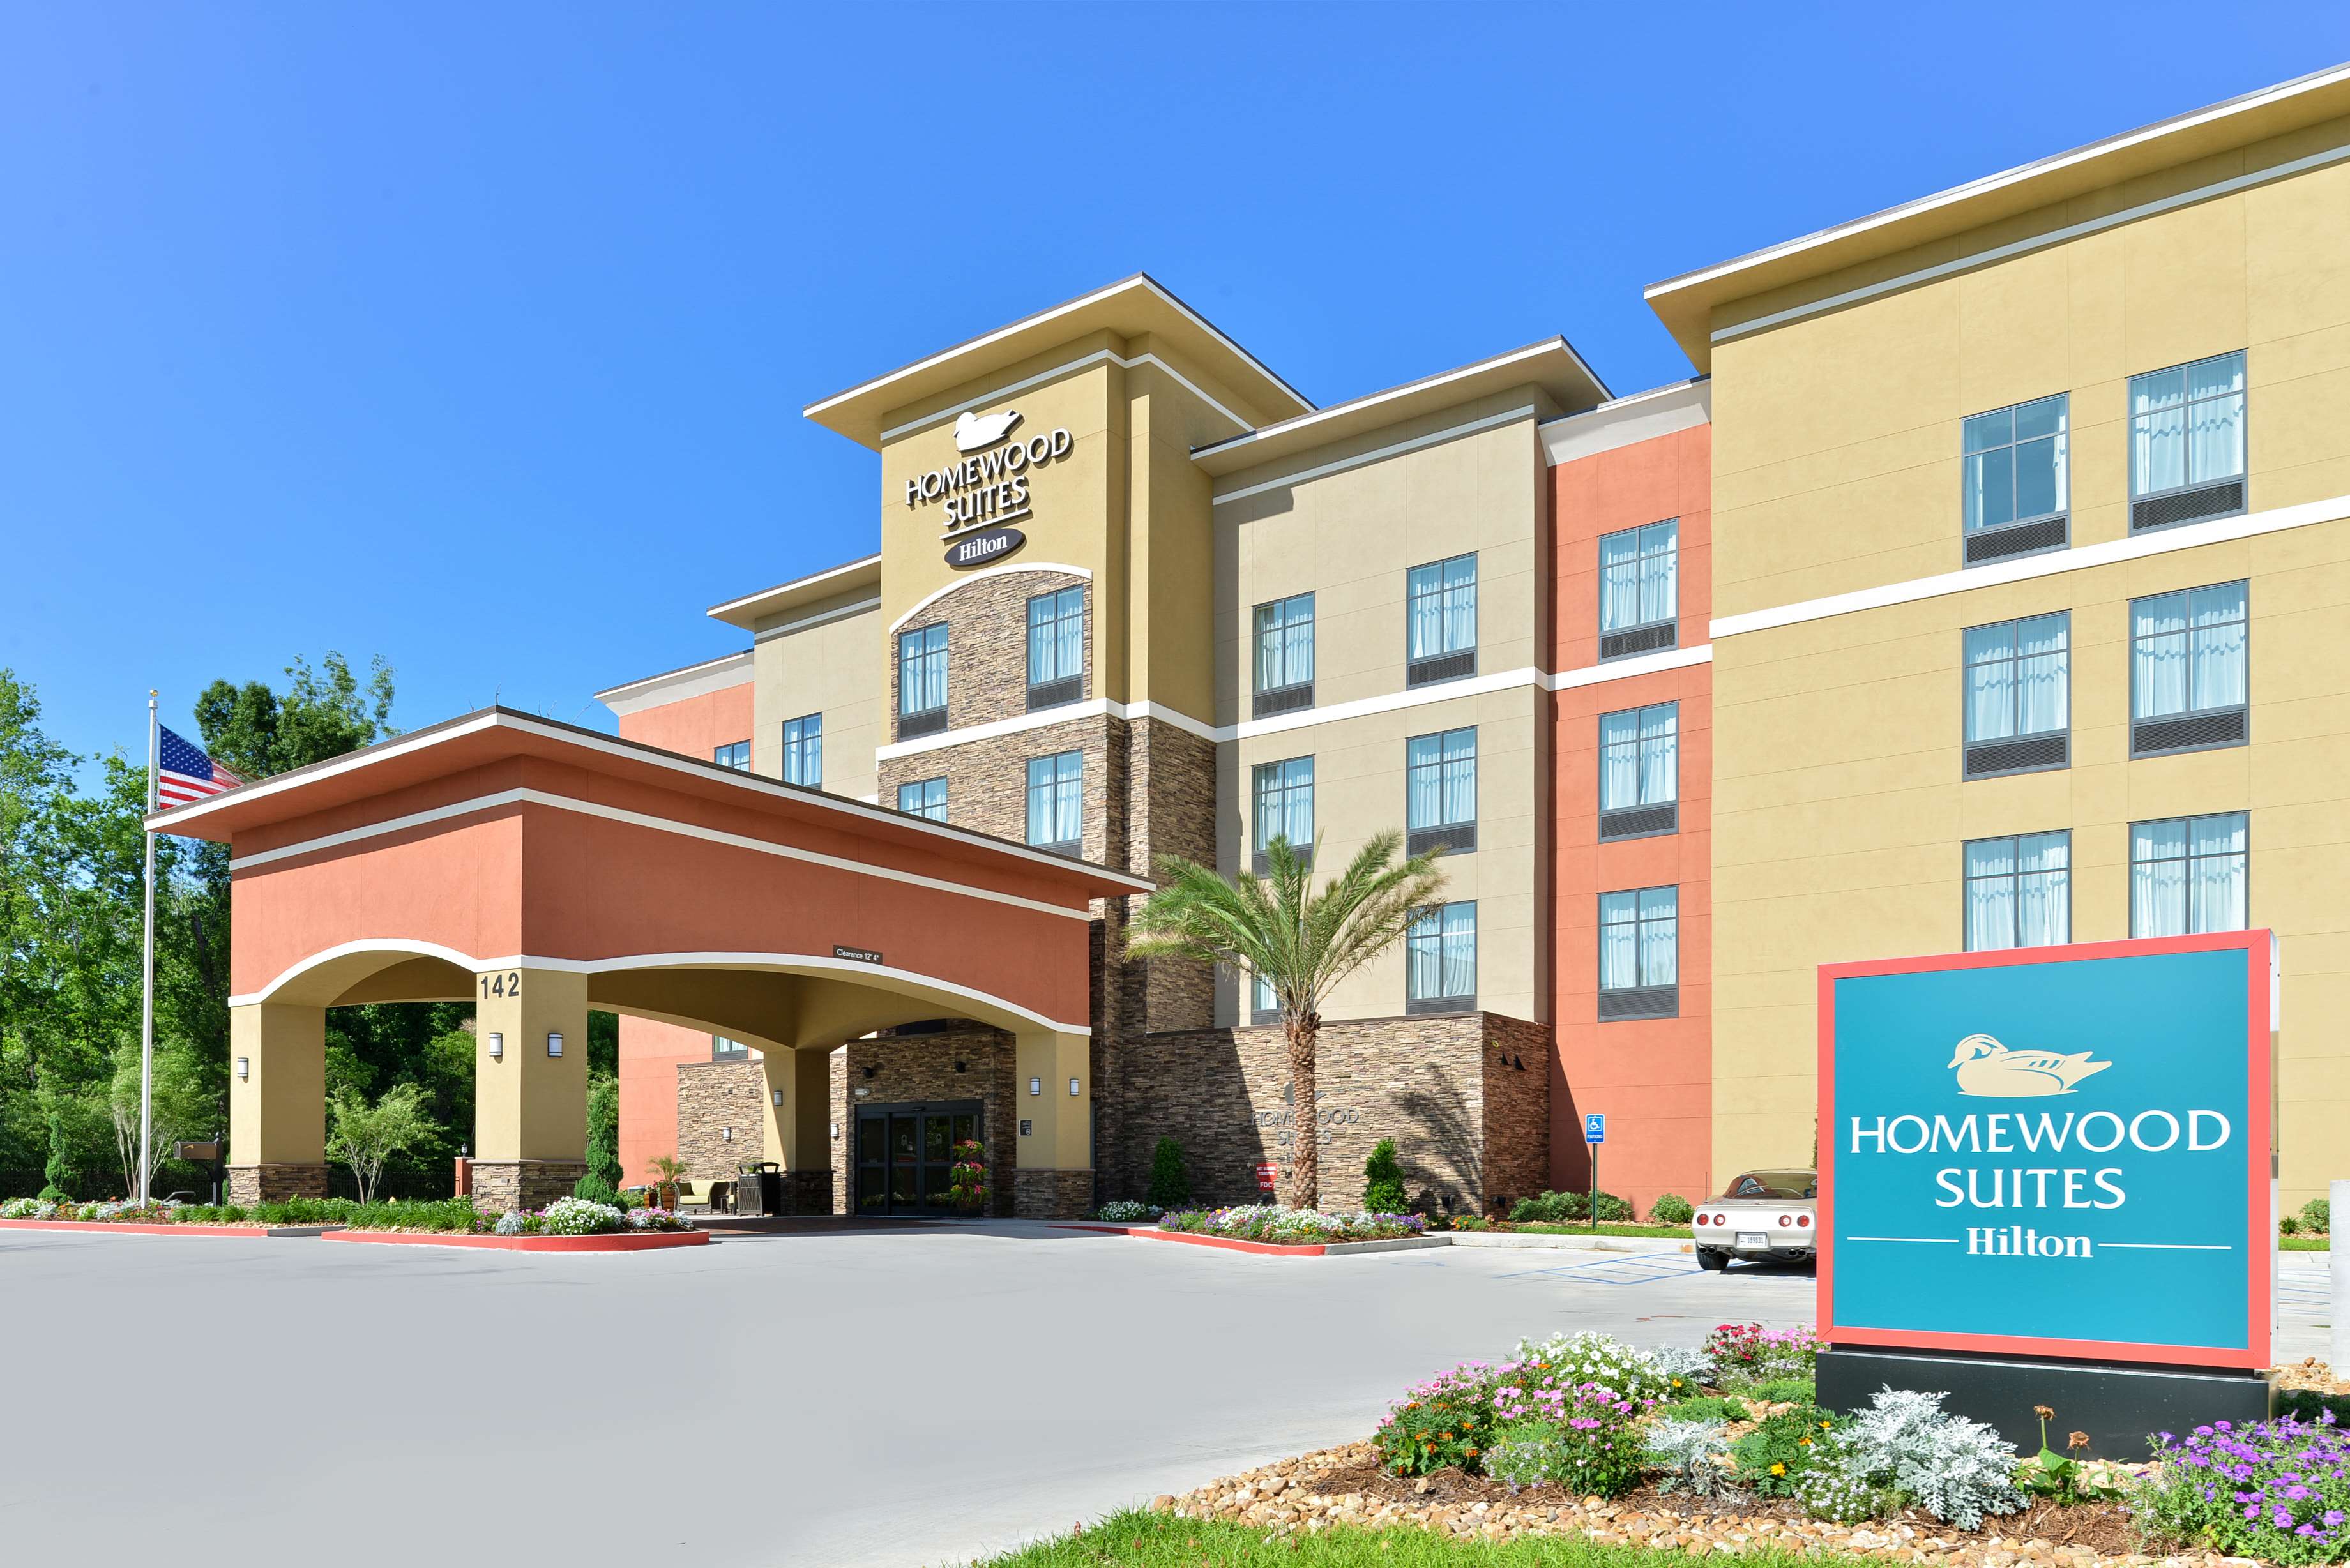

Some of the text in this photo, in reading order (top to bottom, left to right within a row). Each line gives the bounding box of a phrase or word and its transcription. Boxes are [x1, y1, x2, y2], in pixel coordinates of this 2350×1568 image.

[905, 428, 1070, 504] HOMEWOOD
[943, 475, 1027, 527] SUITES
[959, 535, 1007, 562] Hilton
[837, 948, 863, 959] Clearance
[481, 972, 519, 1000] 142
[1850, 1109, 2231, 1154] HOMEWOOD
[1935, 1168, 2126, 1210] SUITES
[1966, 1225, 2093, 1258] Hilton
